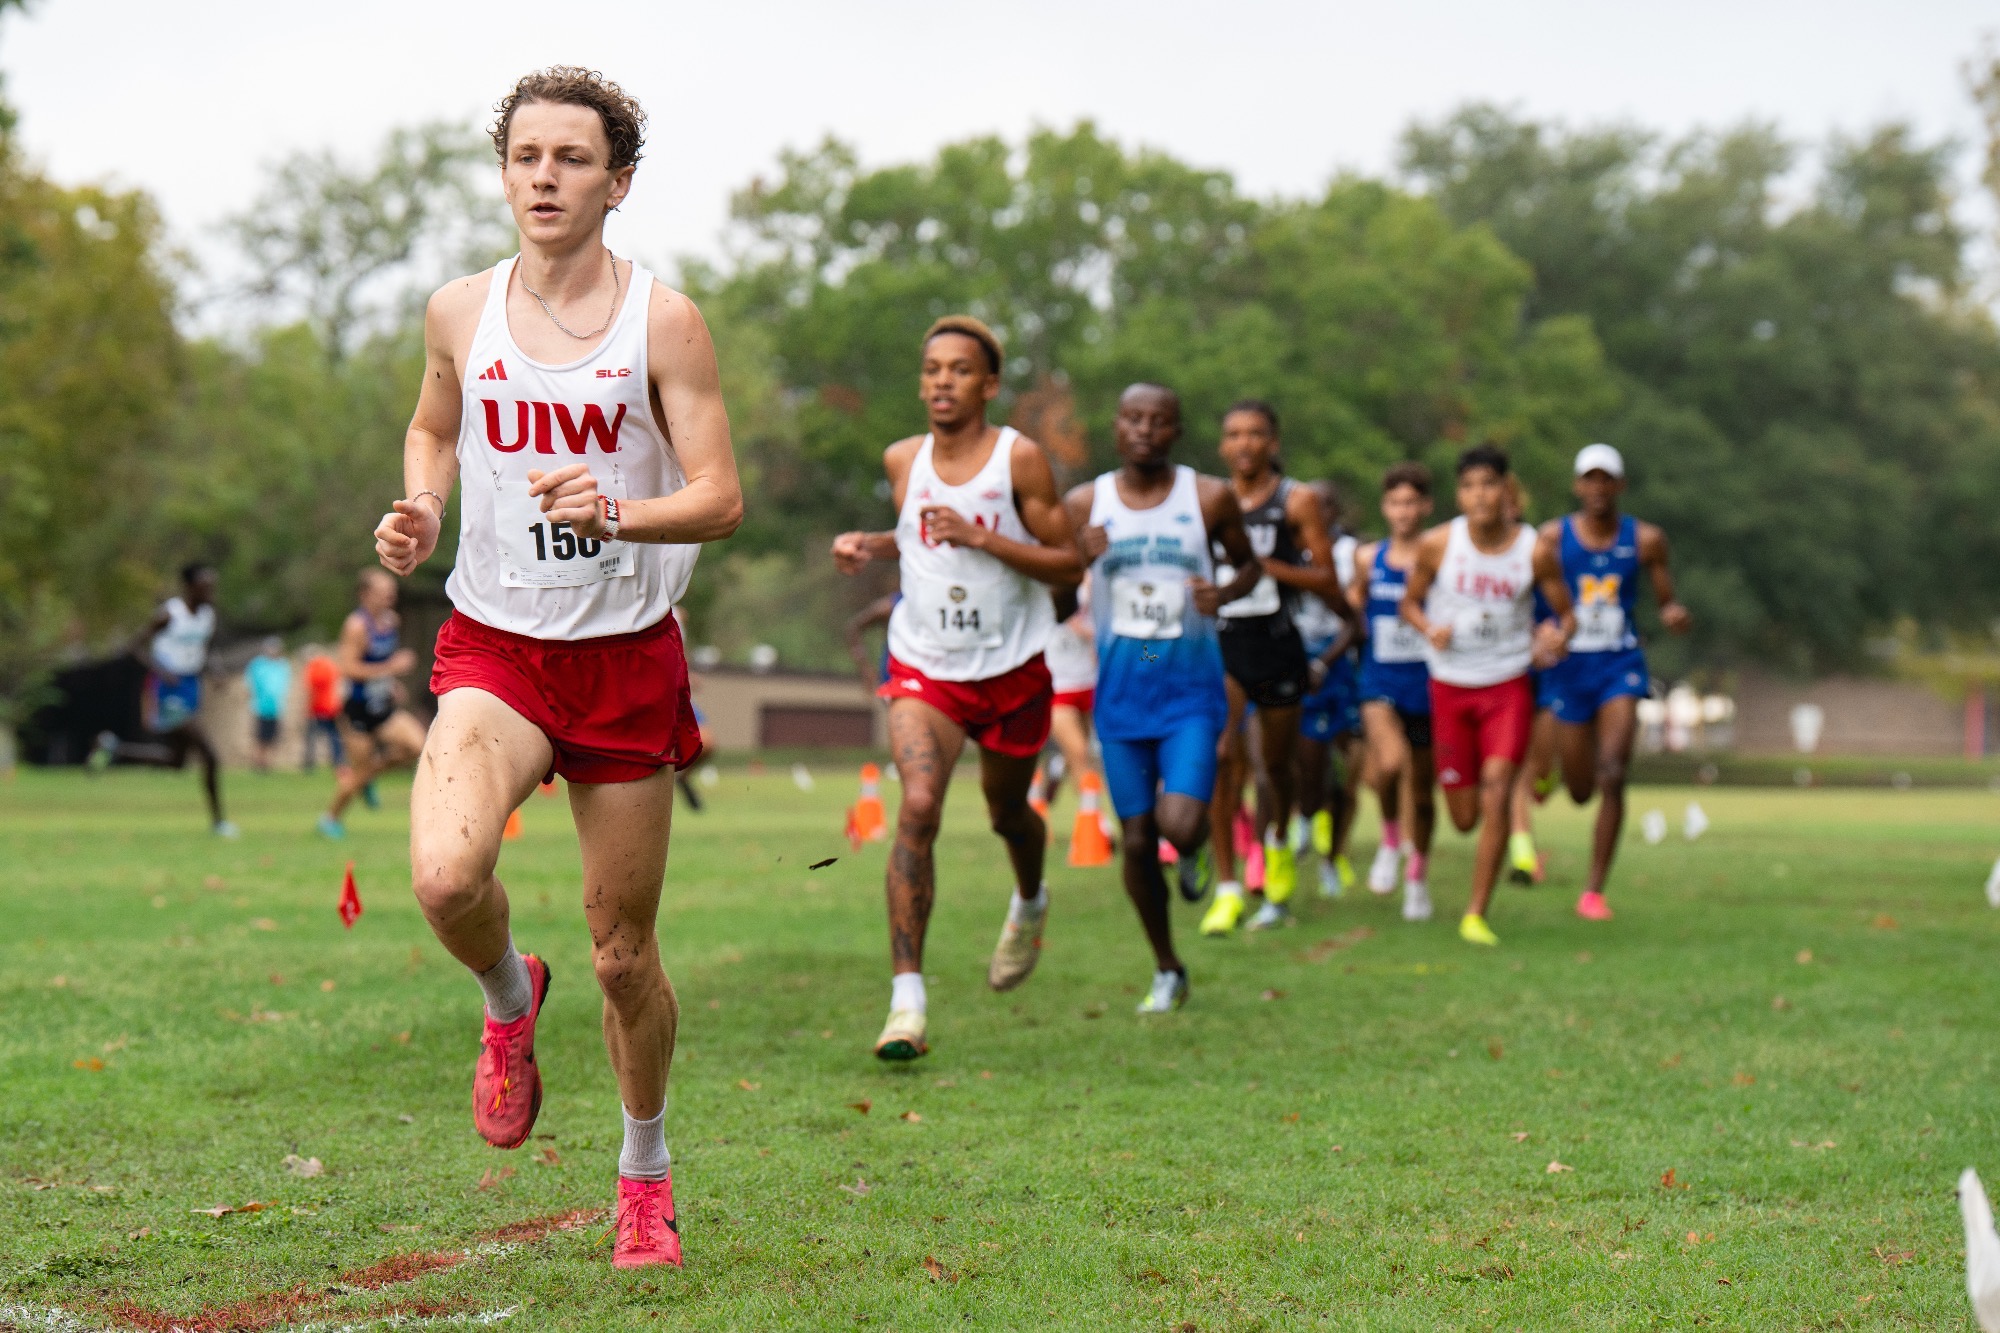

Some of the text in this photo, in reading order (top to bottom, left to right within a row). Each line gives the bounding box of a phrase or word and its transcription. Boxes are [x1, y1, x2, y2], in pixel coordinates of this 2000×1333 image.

[595, 368, 632, 378] SLC
[480, 398, 627, 454] UIW
[528, 522, 601, 561] 150
[939, 608, 980, 631] 144
